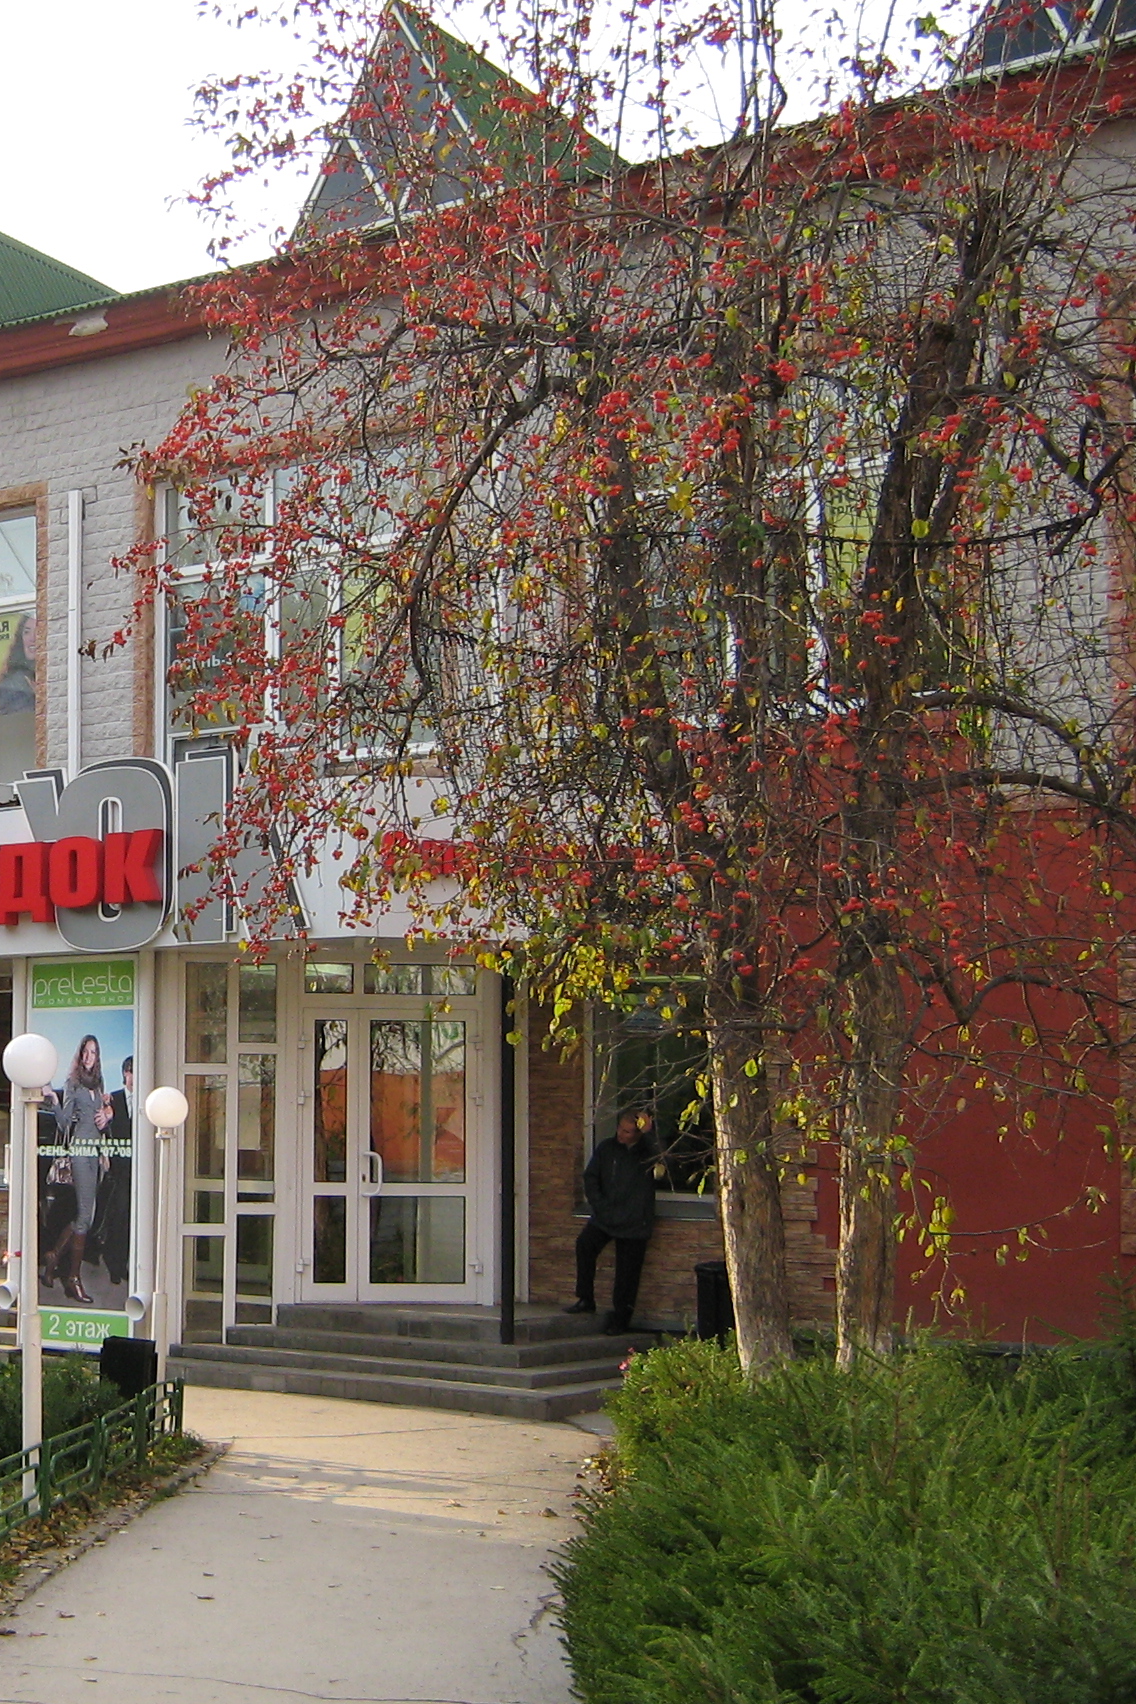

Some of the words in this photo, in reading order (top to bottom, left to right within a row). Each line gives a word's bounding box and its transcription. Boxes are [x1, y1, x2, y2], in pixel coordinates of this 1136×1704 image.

[33, 965, 133, 1006] prelesta
[100, 995, 133, 1003] SHOP
[49, 1314, 60, 1335] 2
[65, 1320, 111, 1338] этаж
